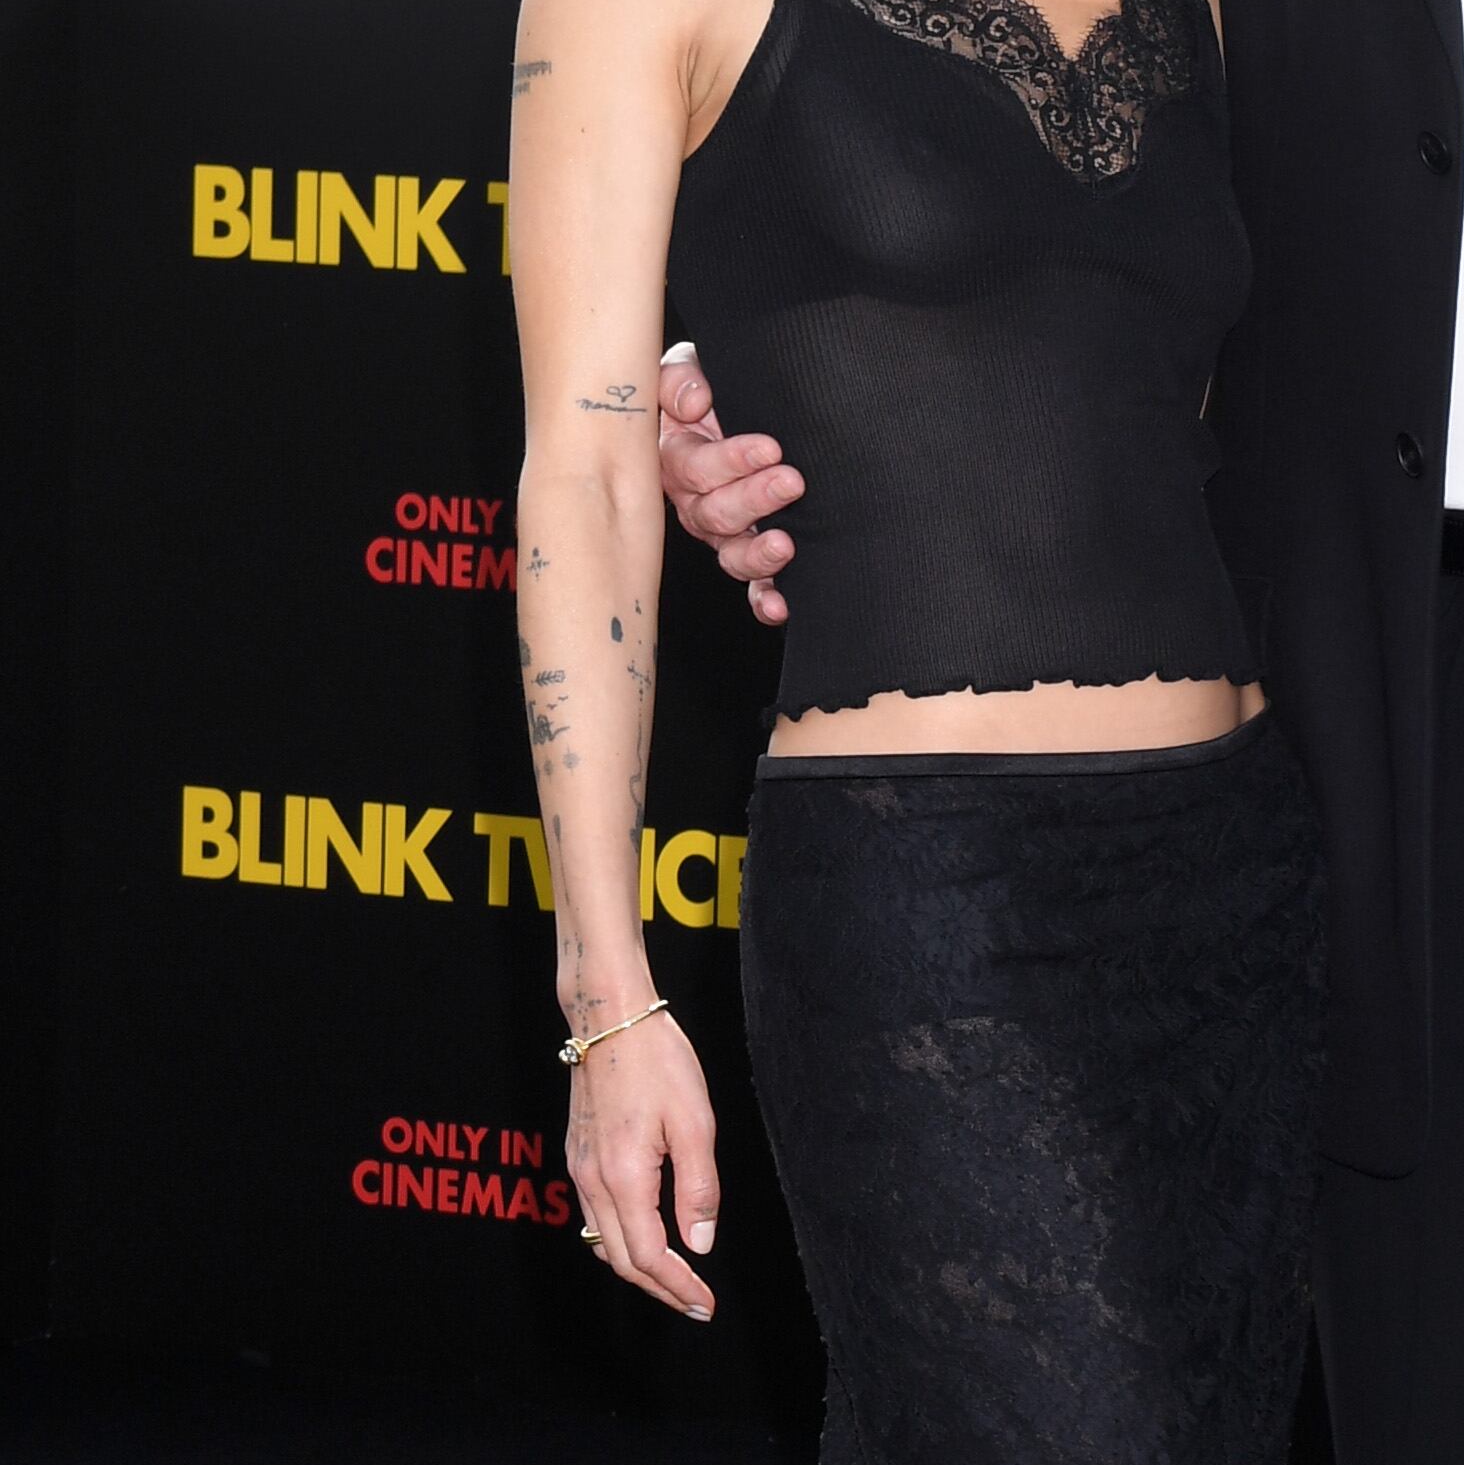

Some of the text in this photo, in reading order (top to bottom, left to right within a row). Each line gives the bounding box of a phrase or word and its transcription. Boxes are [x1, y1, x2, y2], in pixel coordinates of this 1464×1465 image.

[192, 164, 466, 274] BLINK
[395, 491, 503, 535] ONLY
[364, 535, 518, 593] CINEM
[181, 785, 453, 902] BLINK
[381, 1116, 544, 1168] ONLY IN
[351, 1158, 571, 1228] CINEMAS
